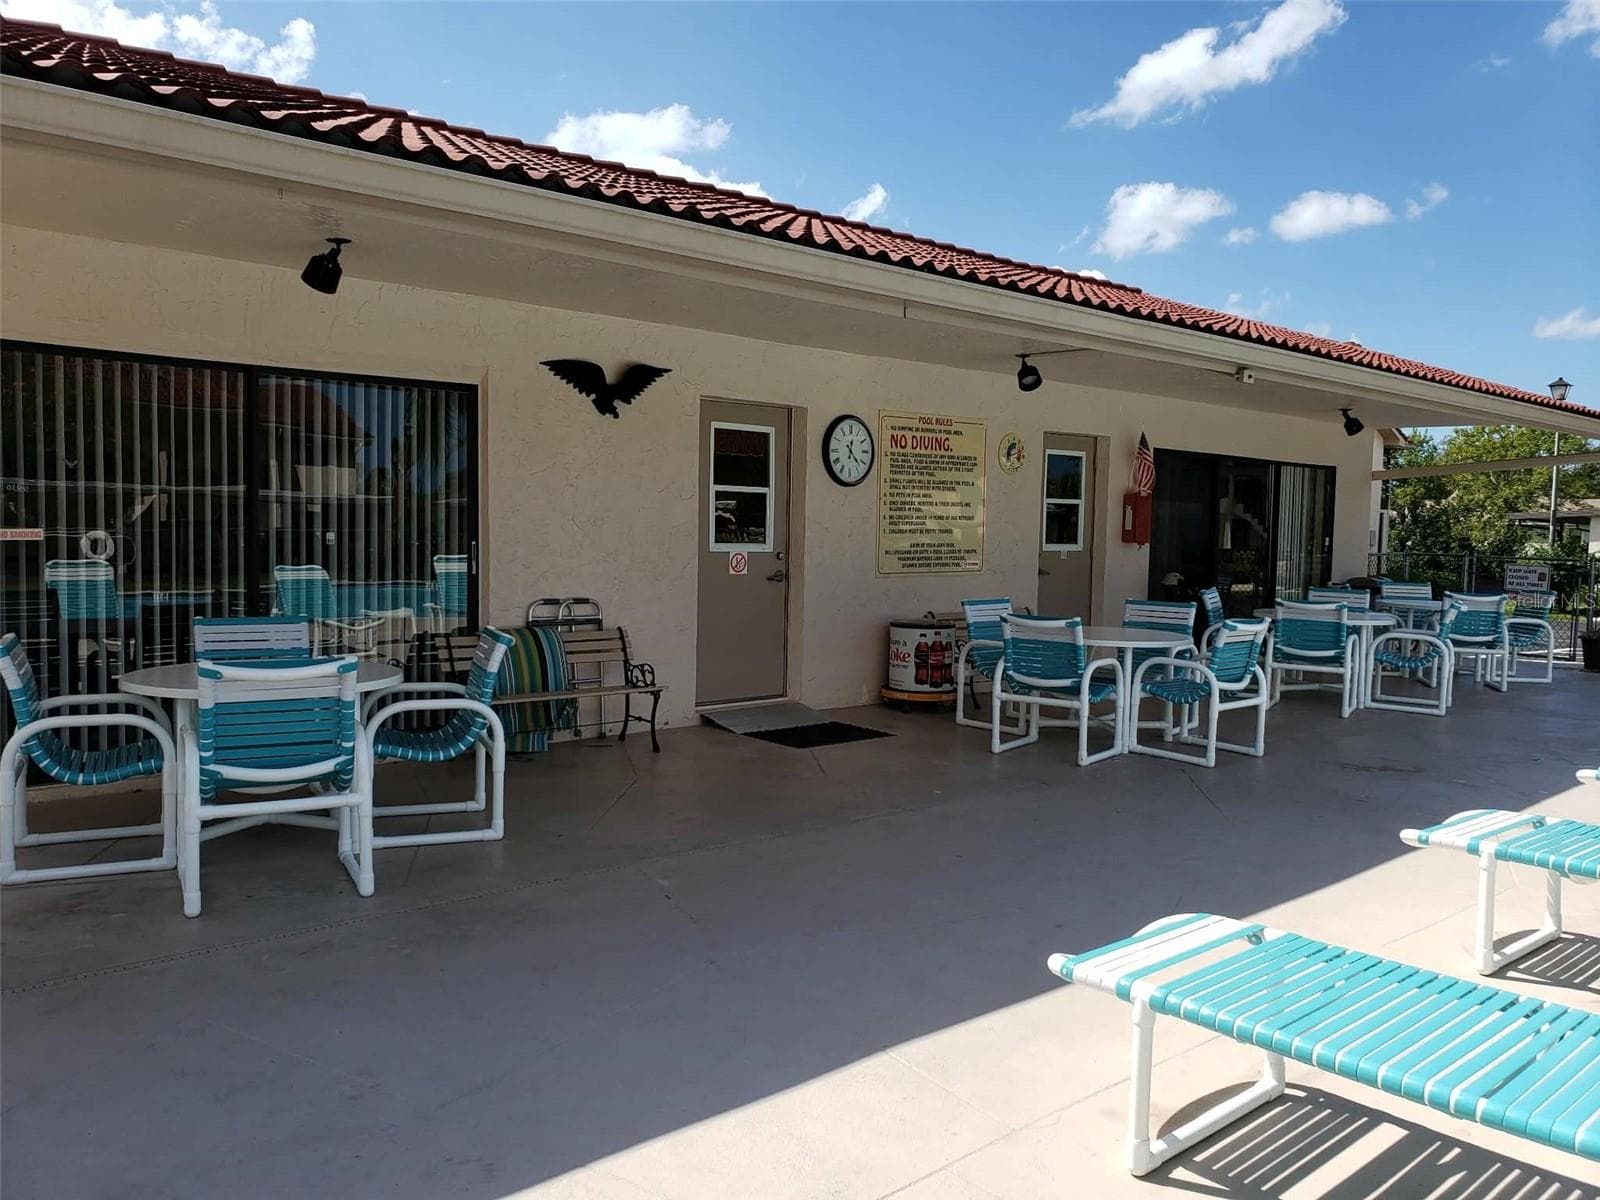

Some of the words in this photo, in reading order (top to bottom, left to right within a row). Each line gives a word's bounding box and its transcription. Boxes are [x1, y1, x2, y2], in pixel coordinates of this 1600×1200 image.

[918, 416, 934, 425] POOL
[890, 434, 907, 449] NO
[912, 435, 953, 452] DIVING.
[890, 648, 911, 663] oke
